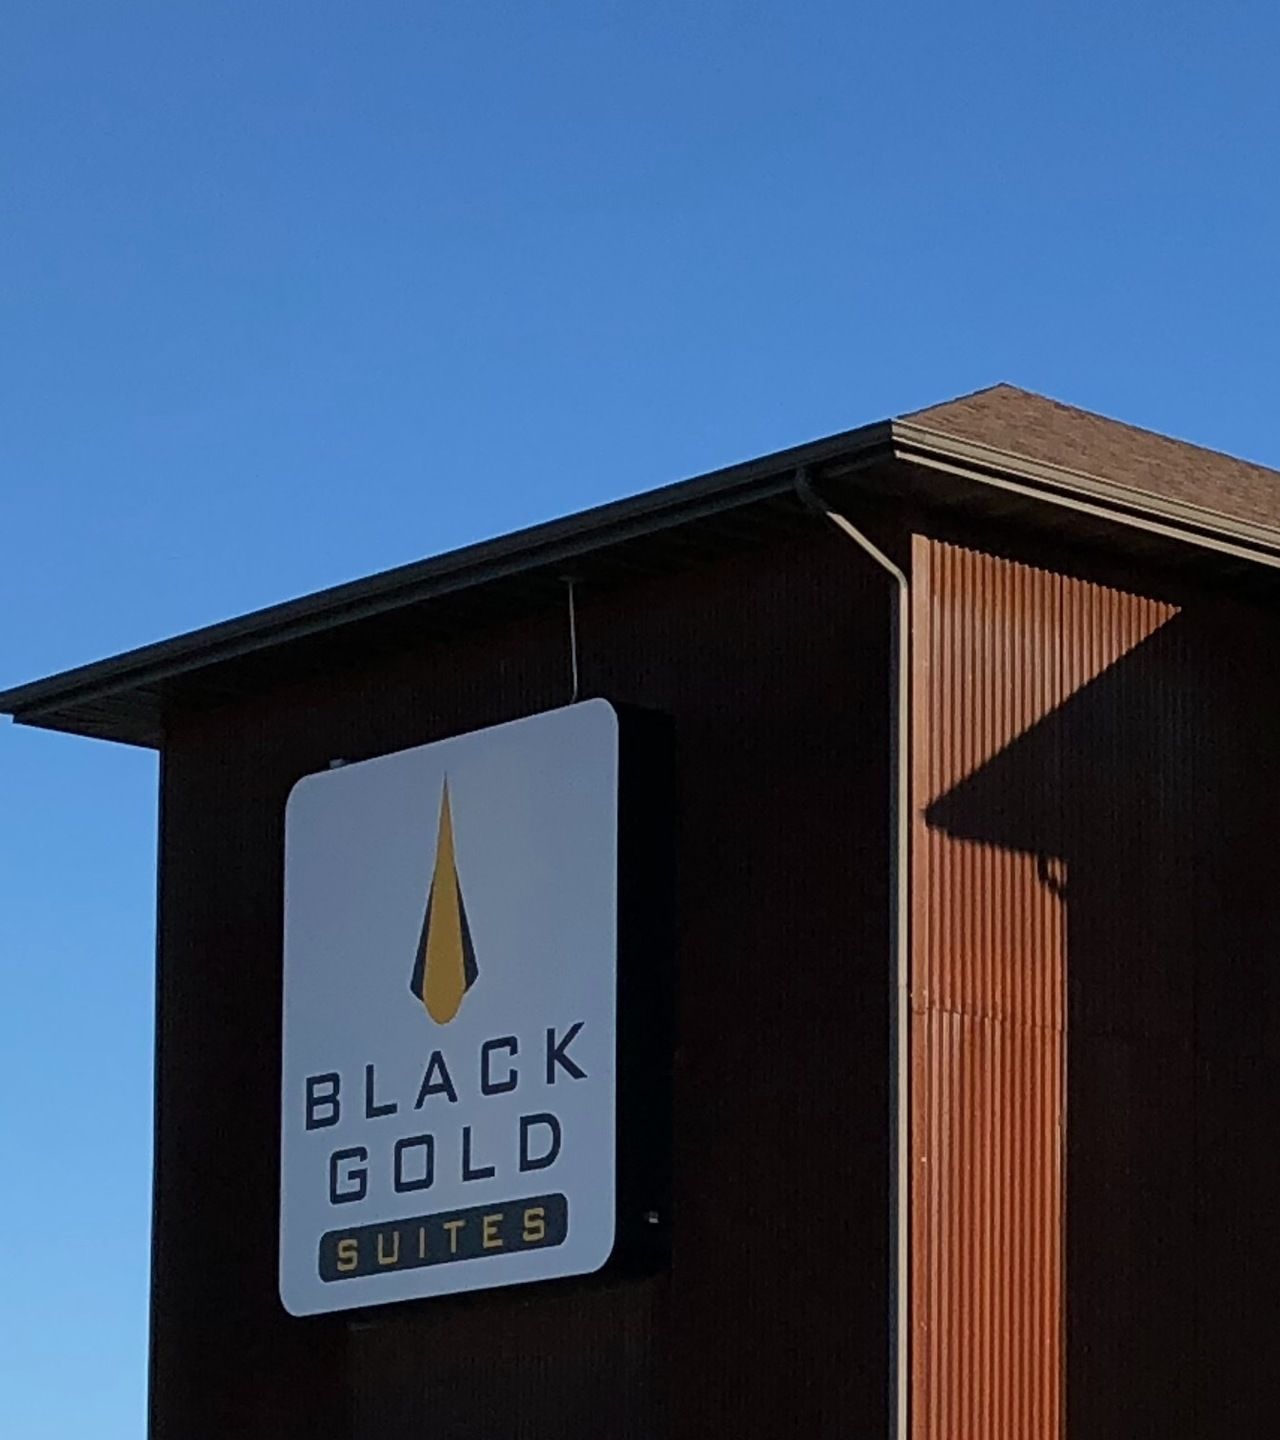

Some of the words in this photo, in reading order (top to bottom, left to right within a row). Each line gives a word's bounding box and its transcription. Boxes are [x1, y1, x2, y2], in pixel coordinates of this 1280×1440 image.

[305, 1022, 588, 1130] BLACK
[329, 1113, 561, 1205] GOLD
[337, 1207, 546, 1271] SUITES
